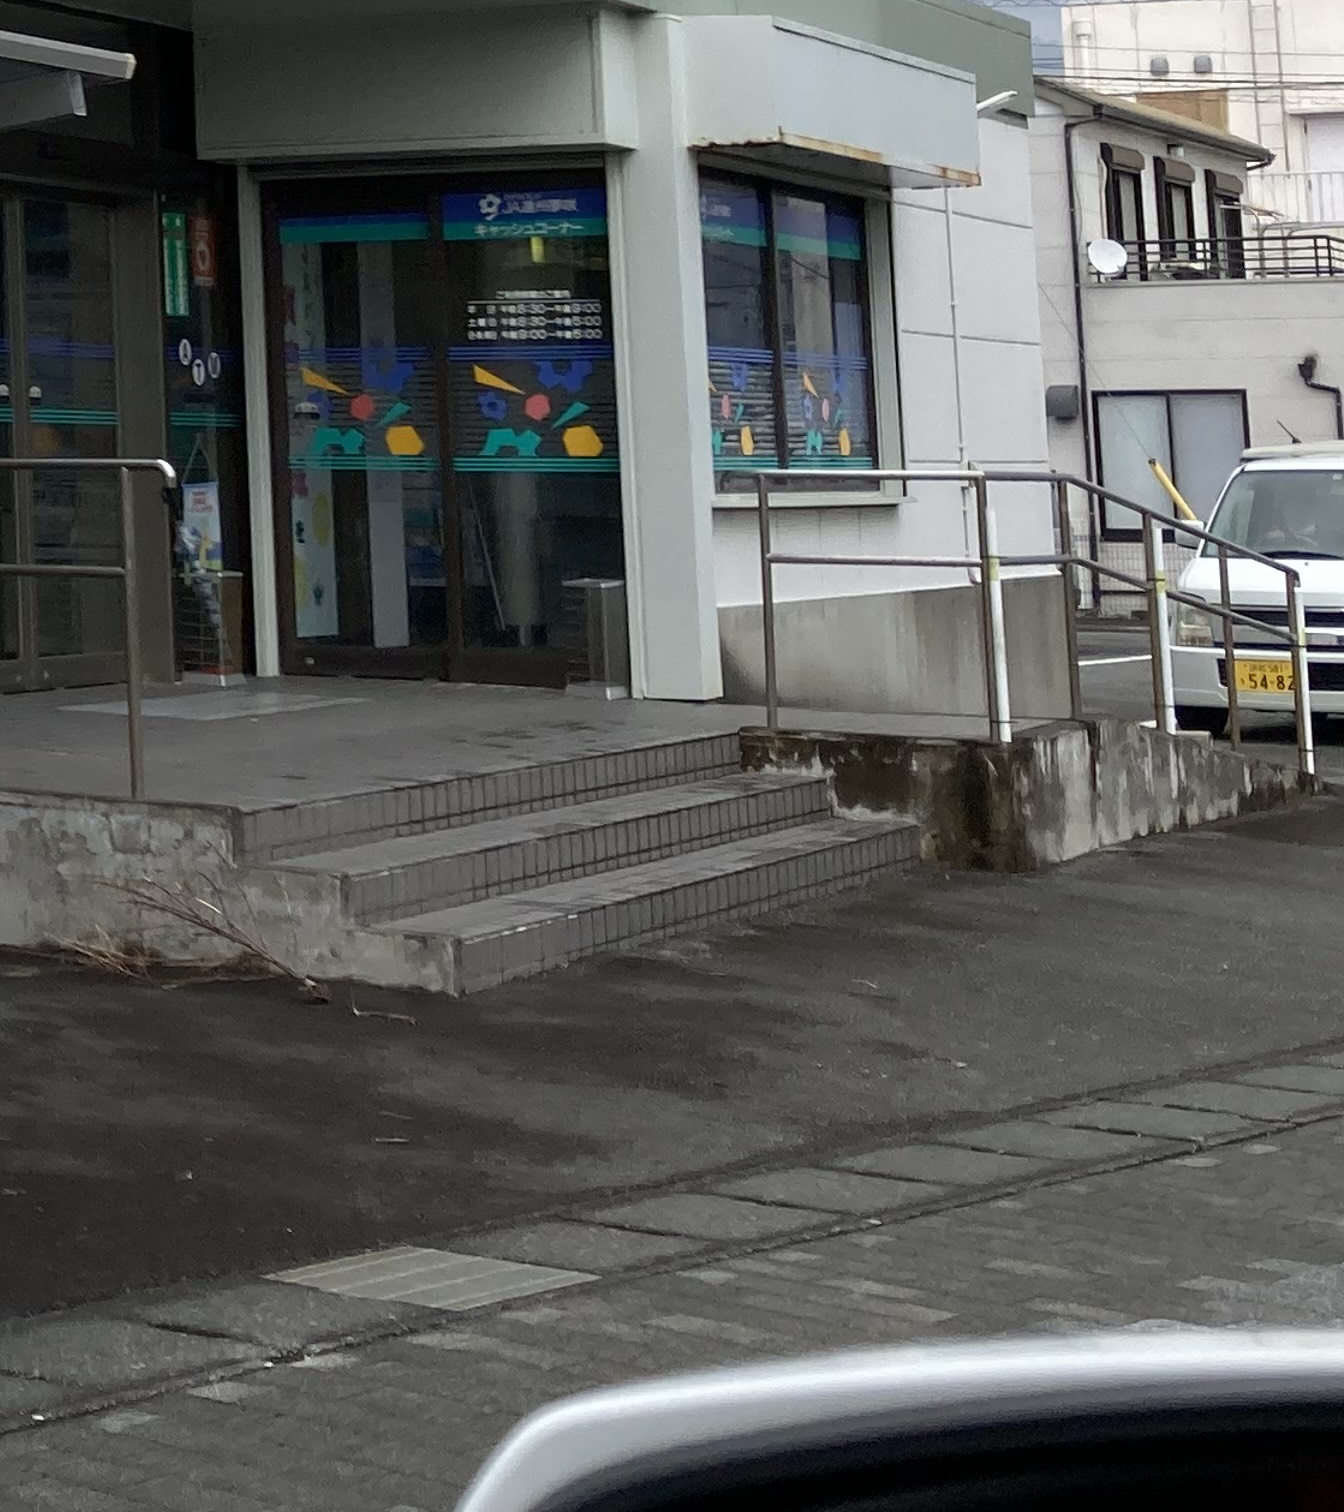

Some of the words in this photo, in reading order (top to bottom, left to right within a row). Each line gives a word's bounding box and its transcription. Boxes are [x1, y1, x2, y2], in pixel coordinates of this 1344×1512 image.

[474, 220, 586, 237] キャッシュコーナー
